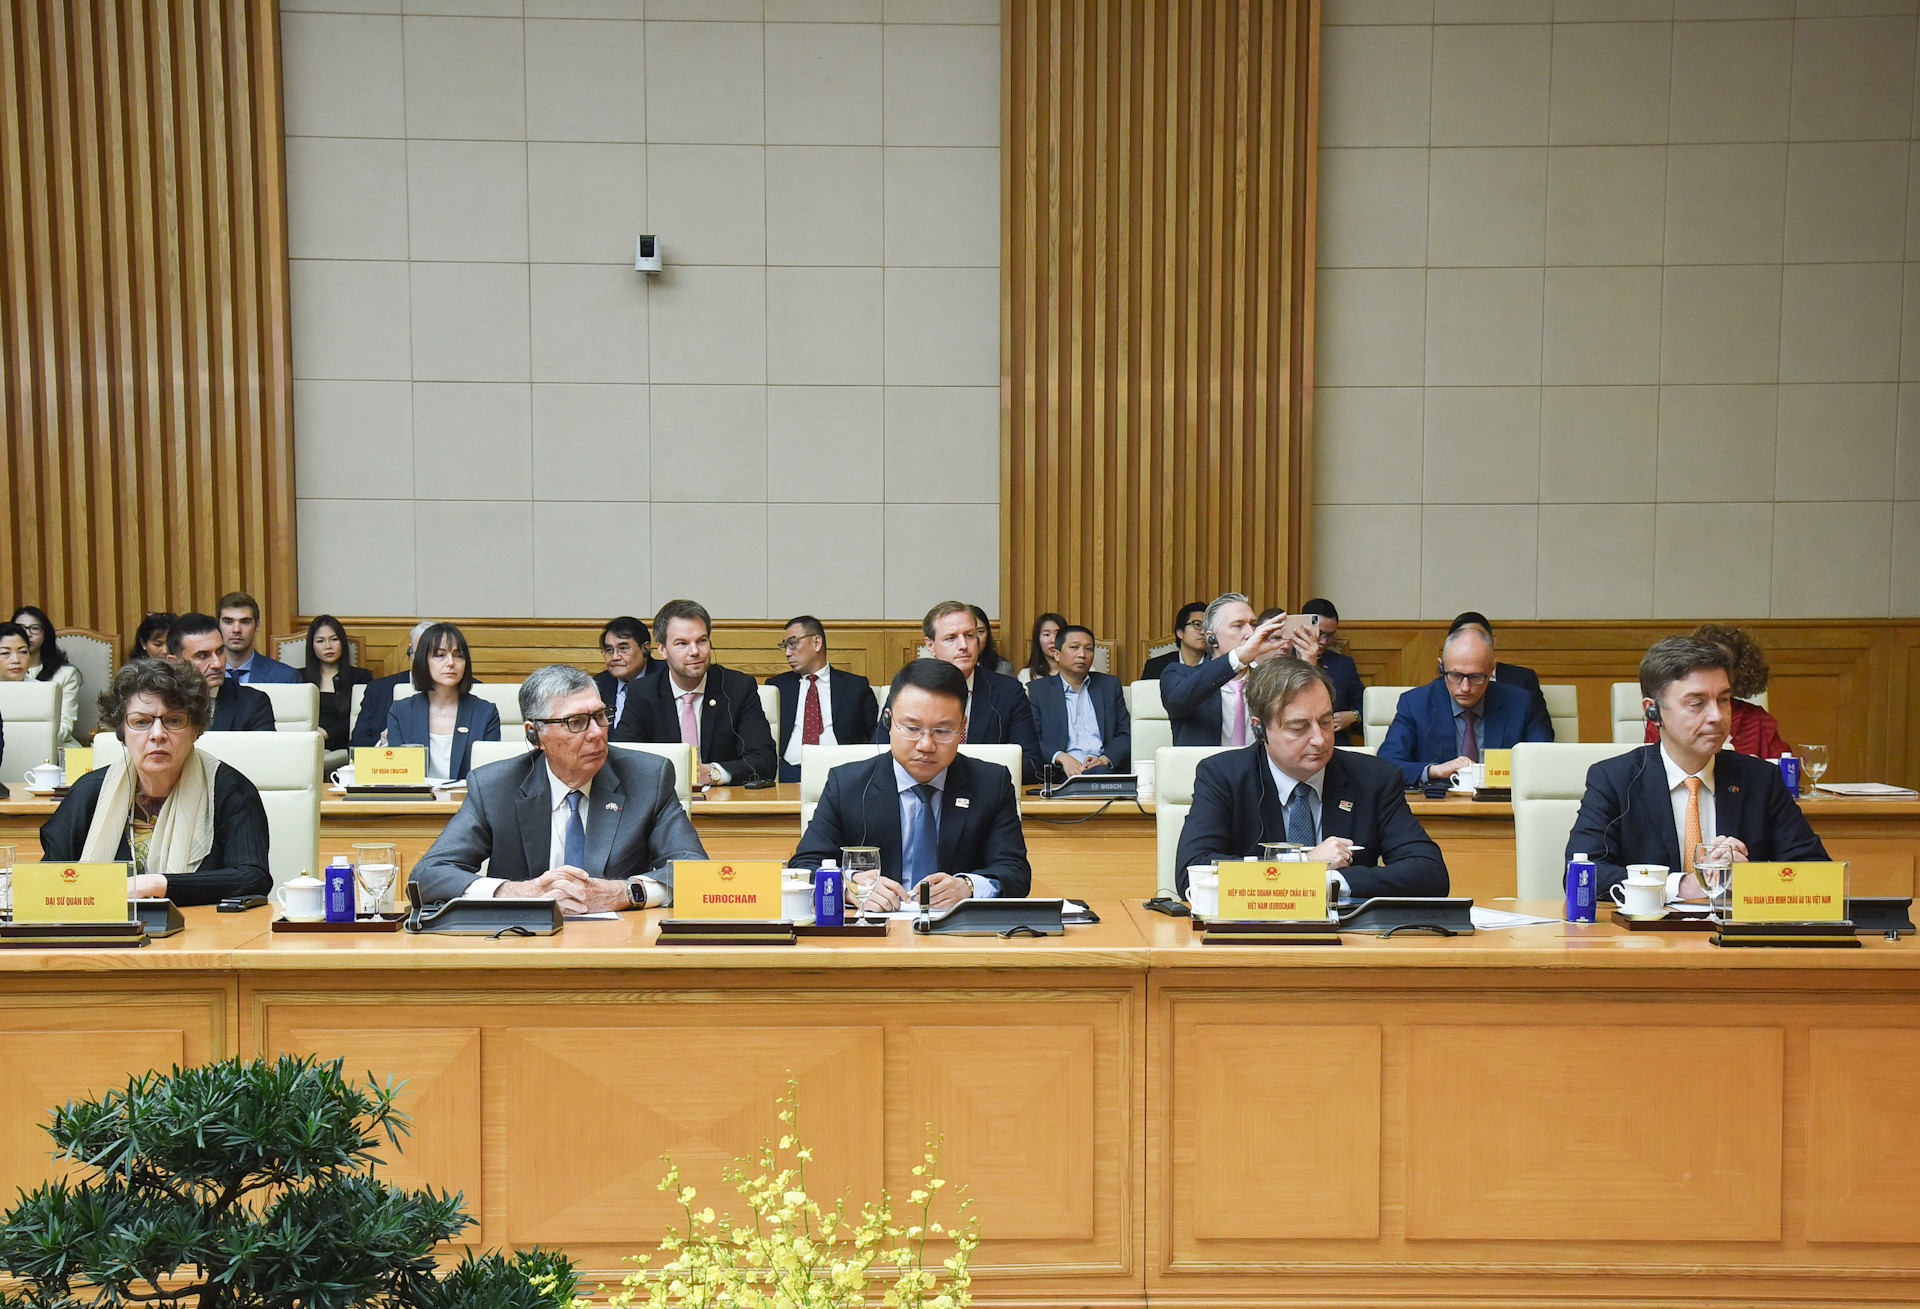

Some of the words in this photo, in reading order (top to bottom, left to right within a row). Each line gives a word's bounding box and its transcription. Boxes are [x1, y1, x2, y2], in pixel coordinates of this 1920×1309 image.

[1247, 888, 1256, 897] CÁC
[1256, 889, 1272, 897] DOANH
[702, 894, 757, 904] EUROCHAM
[1257, 901, 1268, 910] NAM
[1268, 901, 1296, 911] (EUROCHAM)
